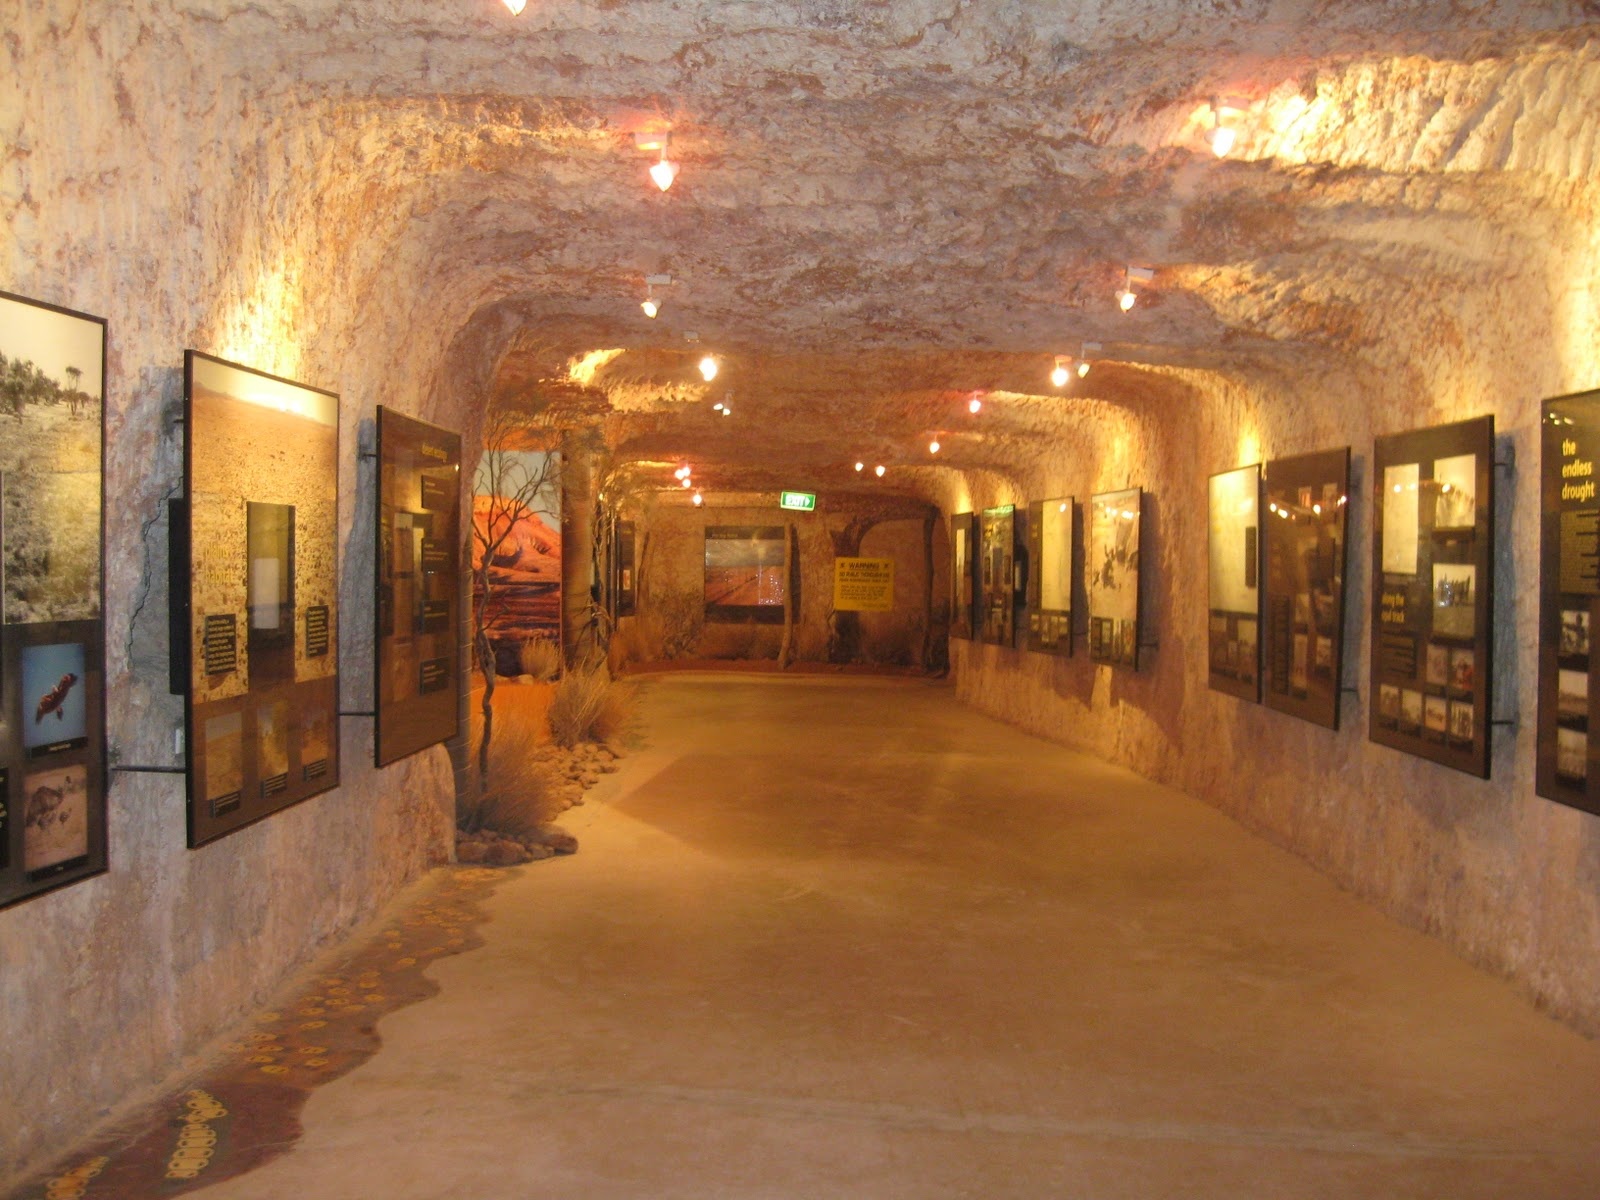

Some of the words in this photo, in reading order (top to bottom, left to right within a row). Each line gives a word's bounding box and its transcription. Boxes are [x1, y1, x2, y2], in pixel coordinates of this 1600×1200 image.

[1562, 438, 1576, 456] the
[1562, 458, 1592, 478] endless
[785, 494, 805, 507] EXIT
[1562, 480, 1595, 503] drought
[849, 562, 879, 570] WARNING
